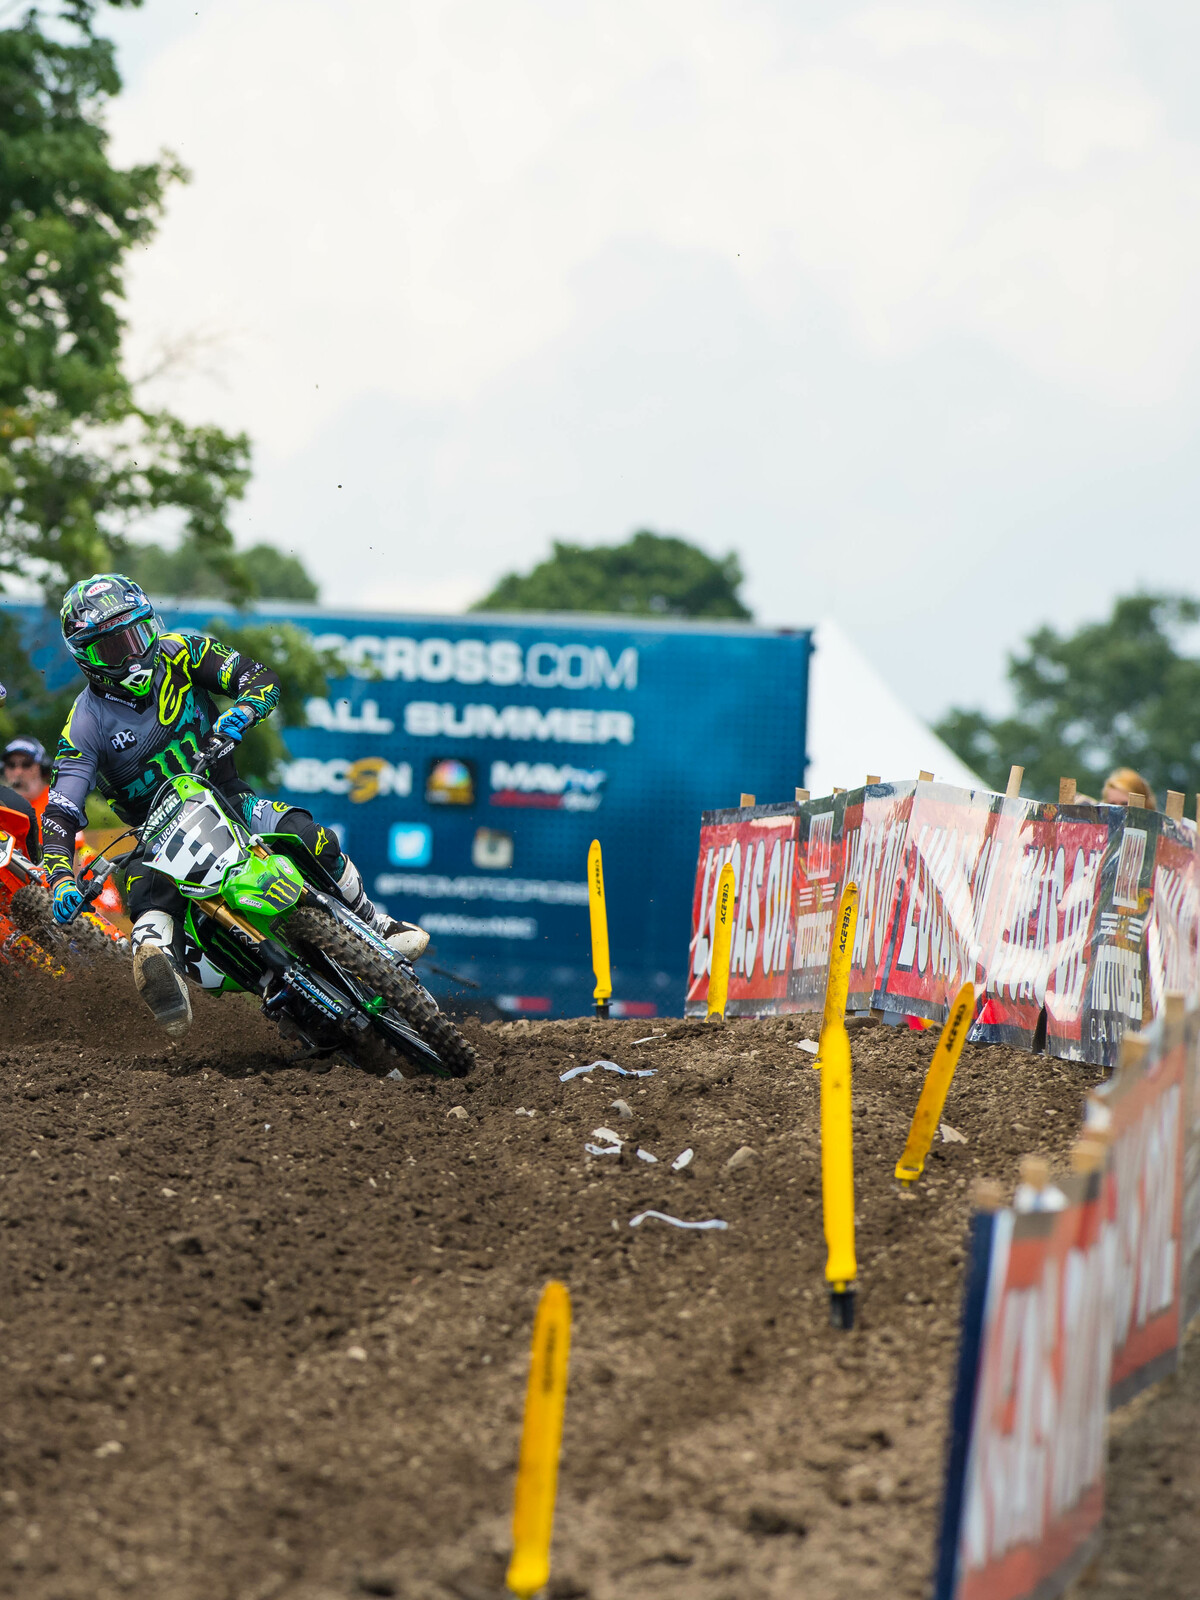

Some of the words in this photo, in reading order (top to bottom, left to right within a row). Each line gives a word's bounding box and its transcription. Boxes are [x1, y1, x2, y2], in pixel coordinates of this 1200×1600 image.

[89, 584, 108, 595] BELL
[104, 692, 137, 709] Kawasaki
[305, 696, 394, 735] ALL
[403, 700, 635, 746] SUMMER
[159, 822, 179, 845] LUCAS
[177, 811, 190, 825] OIL
[165, 804, 235, 885] 3
[179, 883, 206, 894] Kawasaki
[720, 882, 730, 926] ACERBIS
[762, 837, 796, 979] OIL
[839, 905, 852, 954] ACERBIS
[282, 971, 337, 1020] DUNLOP
[310, 984, 342, 1013] CARRILLO
[945, 1003, 968, 1053] ACERBIS
